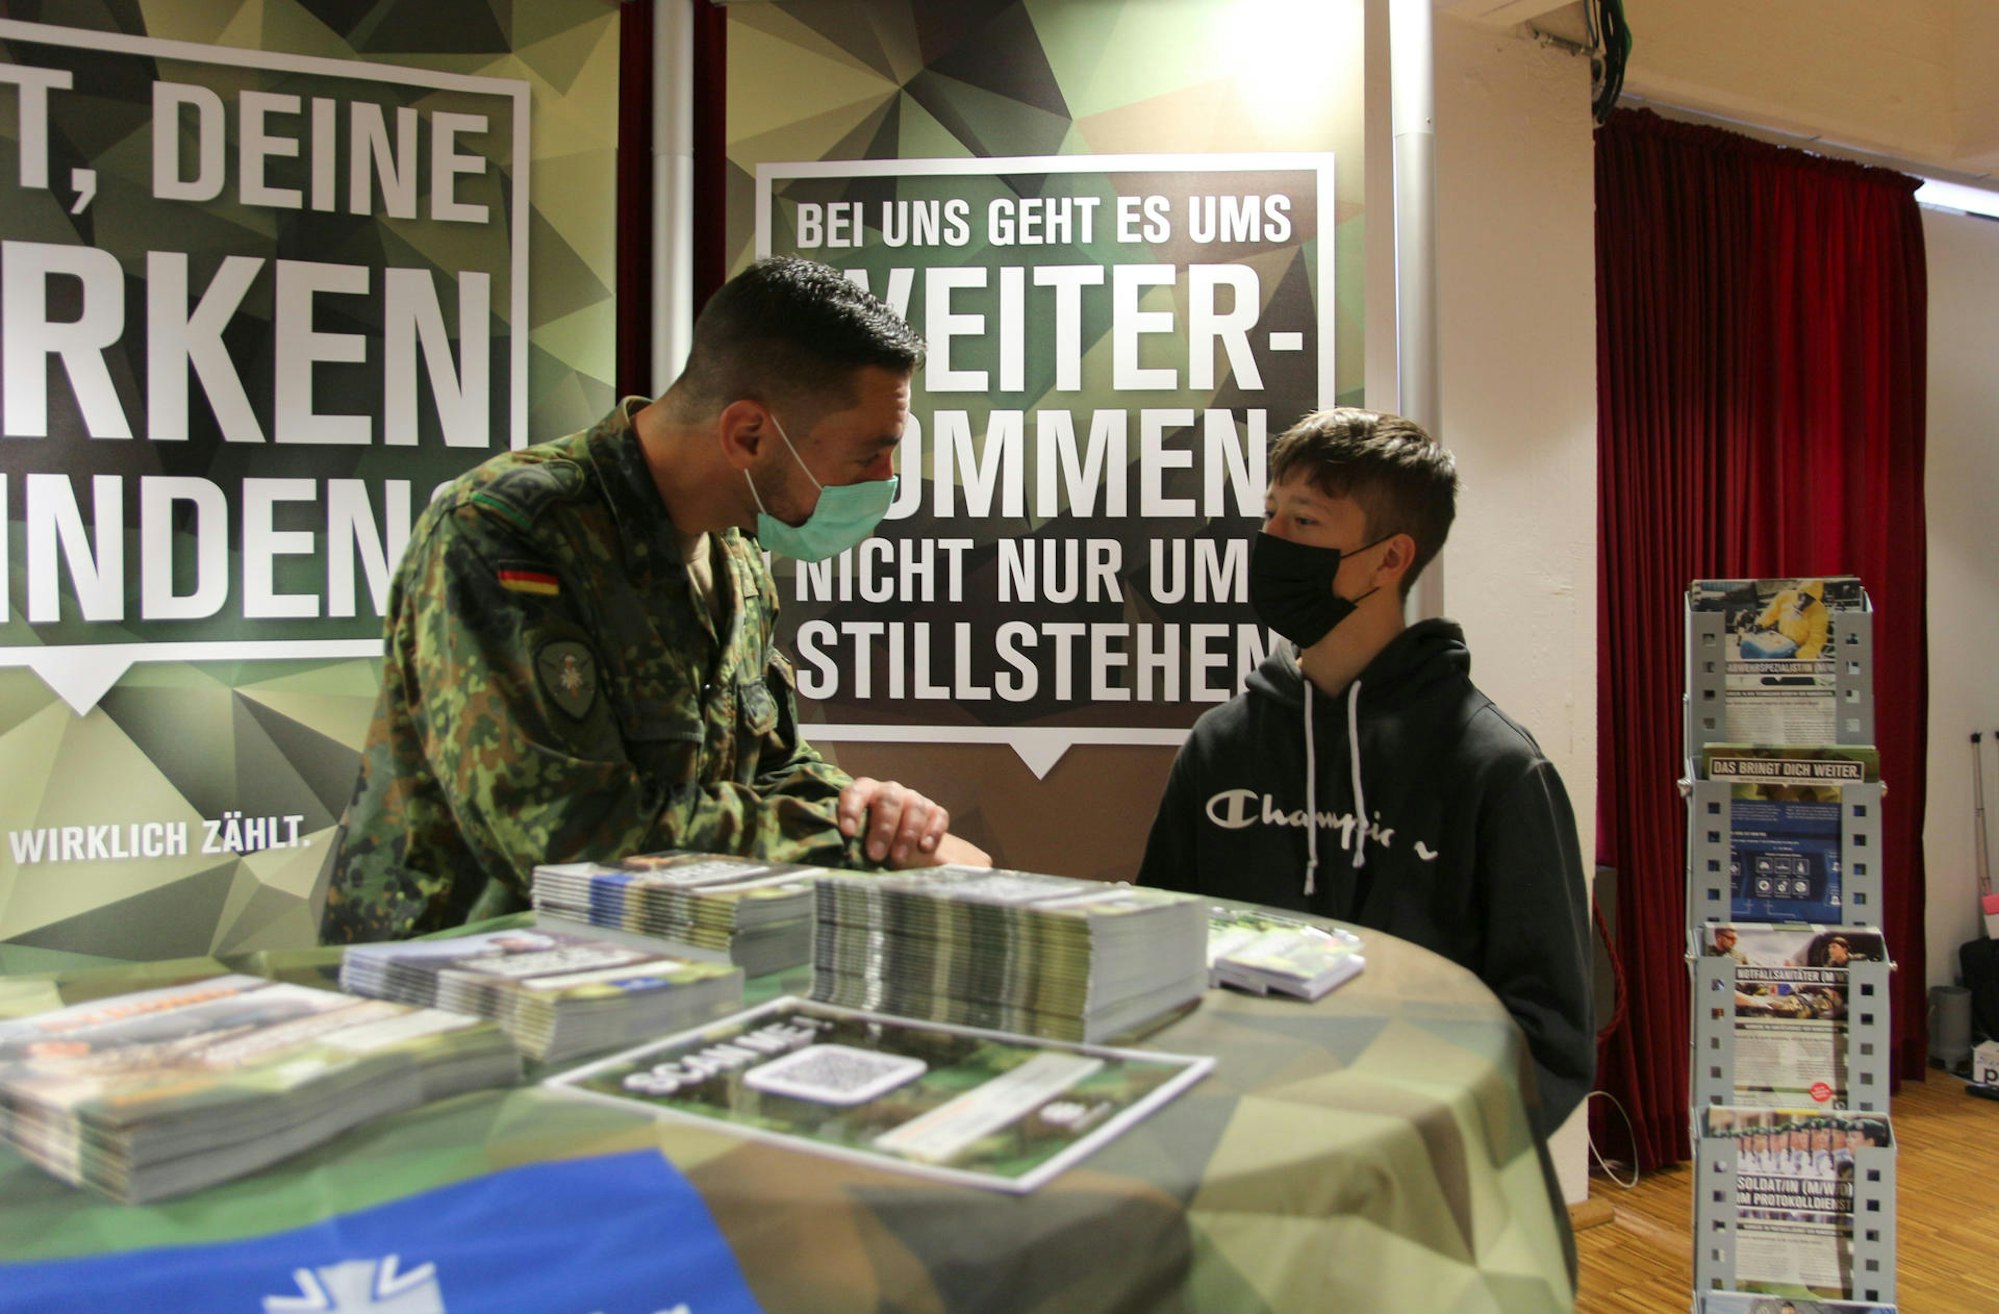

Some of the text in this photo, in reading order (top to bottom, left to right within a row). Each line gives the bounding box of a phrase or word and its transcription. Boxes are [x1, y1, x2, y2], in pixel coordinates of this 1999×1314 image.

[152, 80, 489, 224] DEINE
[797, 193, 1293, 249] BEI UNS GEHT ES UMS
[1, 239, 490, 448] RKEN
[0, 473, 455, 623] NDEN
[796, 537, 974, 603] NICHT
[998, 538, 1124, 603] NUR
[796, 619, 1281, 703] STILLSTEHEN
[1713, 760, 1860, 779] DAS BRINGT DICH WEITER.
[9, 811, 311, 865] WIRKLICH ZÄHLT.
[1737, 1175, 1799, 1194] SOLDAT/IN
